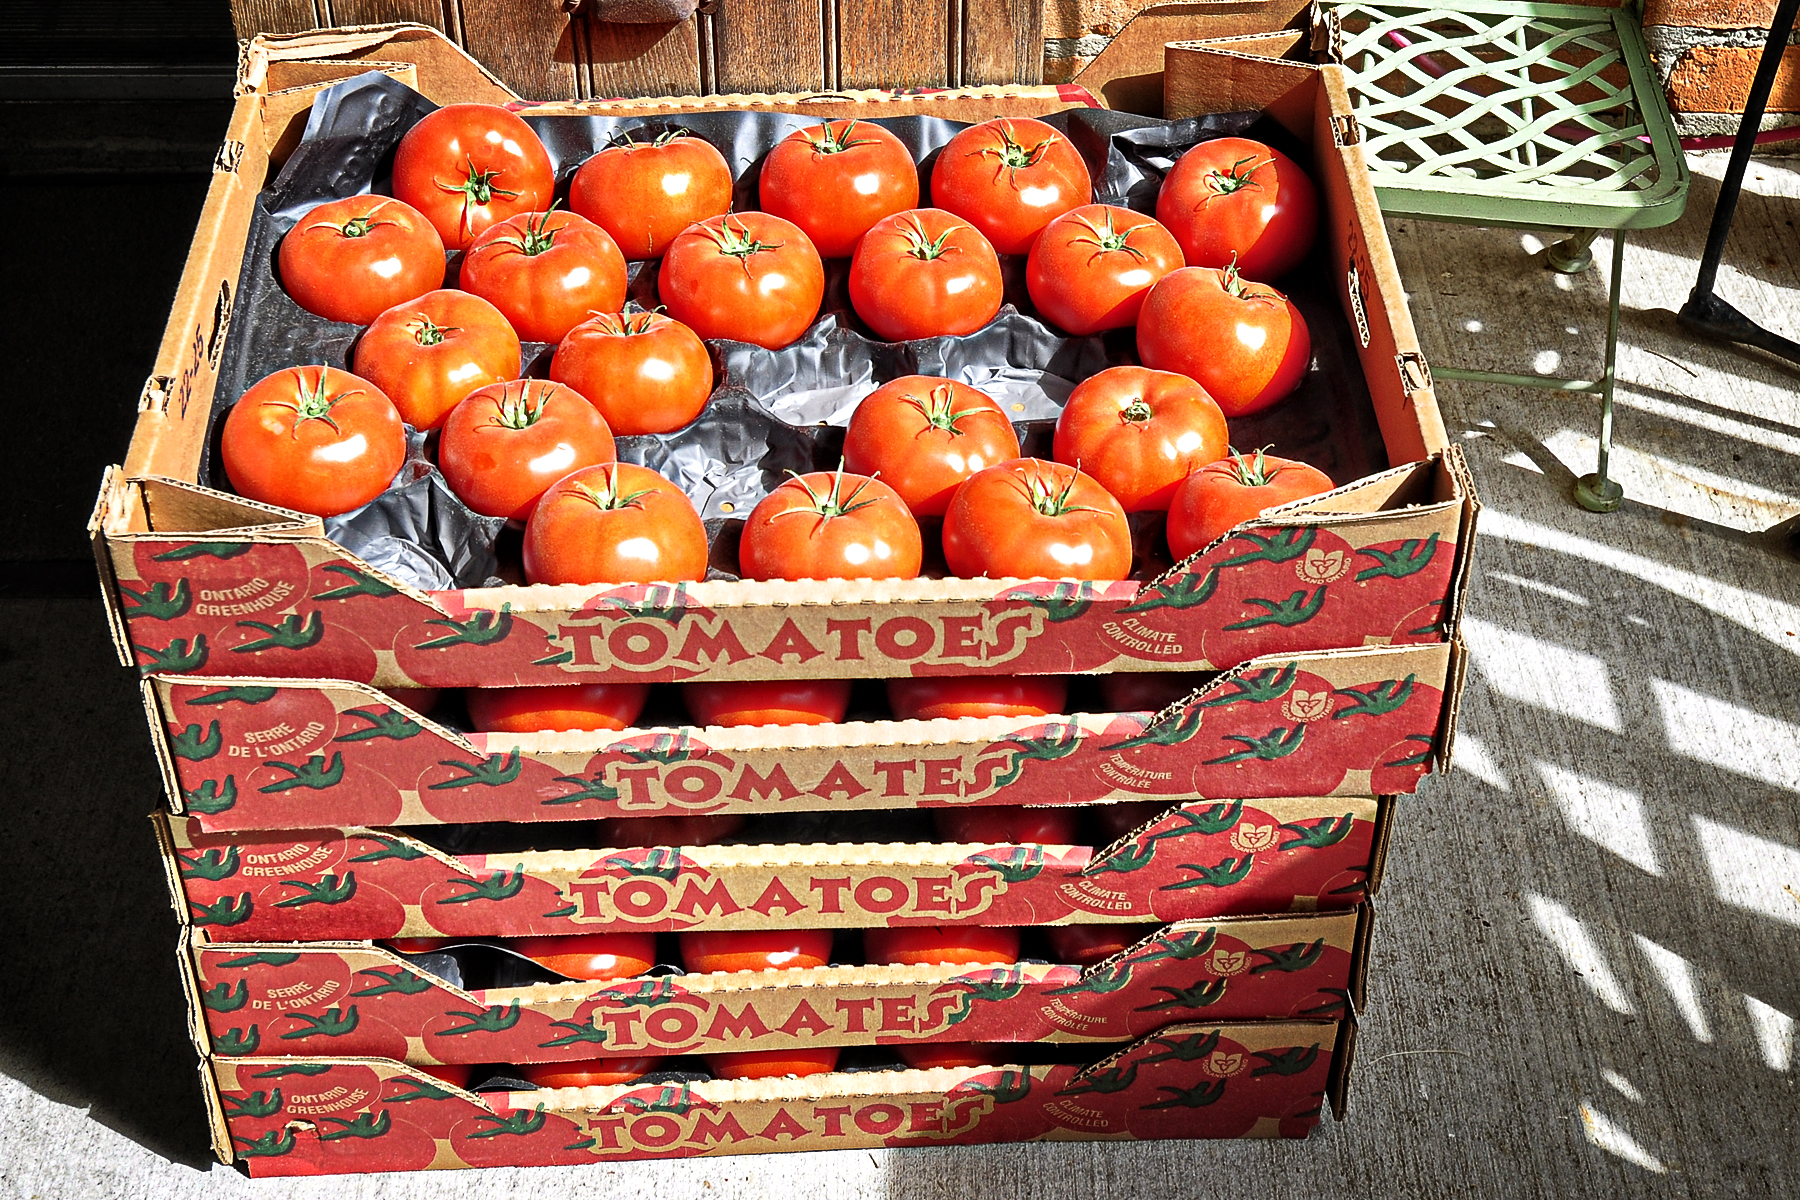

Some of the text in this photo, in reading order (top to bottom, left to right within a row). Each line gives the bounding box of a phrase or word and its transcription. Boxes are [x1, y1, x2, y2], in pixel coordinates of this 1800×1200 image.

[1295, 557, 1352, 585] FOODLAND ONTARIO
[196, 580, 296, 617] GREENHOUSE
[201, 577, 270, 602] ONTARIO
[557, 611, 1033, 666] TOMATOES
[1102, 621, 1183, 655] CONTROLLED
[1122, 617, 1177, 643] CLIMATE
[228, 721, 326, 758] DE L'ONTARIO
[244, 722, 296, 744] SERRE
[616, 753, 1008, 805] TOMATES
[1099, 762, 1152, 789] CONTRÔLÉE
[1109, 752, 1172, 780] TEMPÉRATURE
[241, 846, 334, 877] GREENHOUSE
[246, 843, 310, 865] ONTARIO
[568, 875, 997, 919] TOMATOES
[1060, 883, 1132, 910] CONTROLLED
[1078, 880, 1127, 901] CLIMATE
[252, 979, 341, 1011] DE L'ONTARIO
[266, 980, 314, 999] SERRE
[601, 993, 958, 1047] TOMATES
[1040, 1005, 1089, 1031] CONTRÔLÉE
[1050, 997, 1108, 1024] TEMPÉRATURE
[286, 1088, 369, 1115] GREENHOUSE
[291, 1085, 348, 1104] ONTARIO
[1042, 1102, 1109, 1128] CONTROLLED
[1060, 1099, 1104, 1118] CLIMATE
[587, 1096, 985, 1150] TOMATOES
